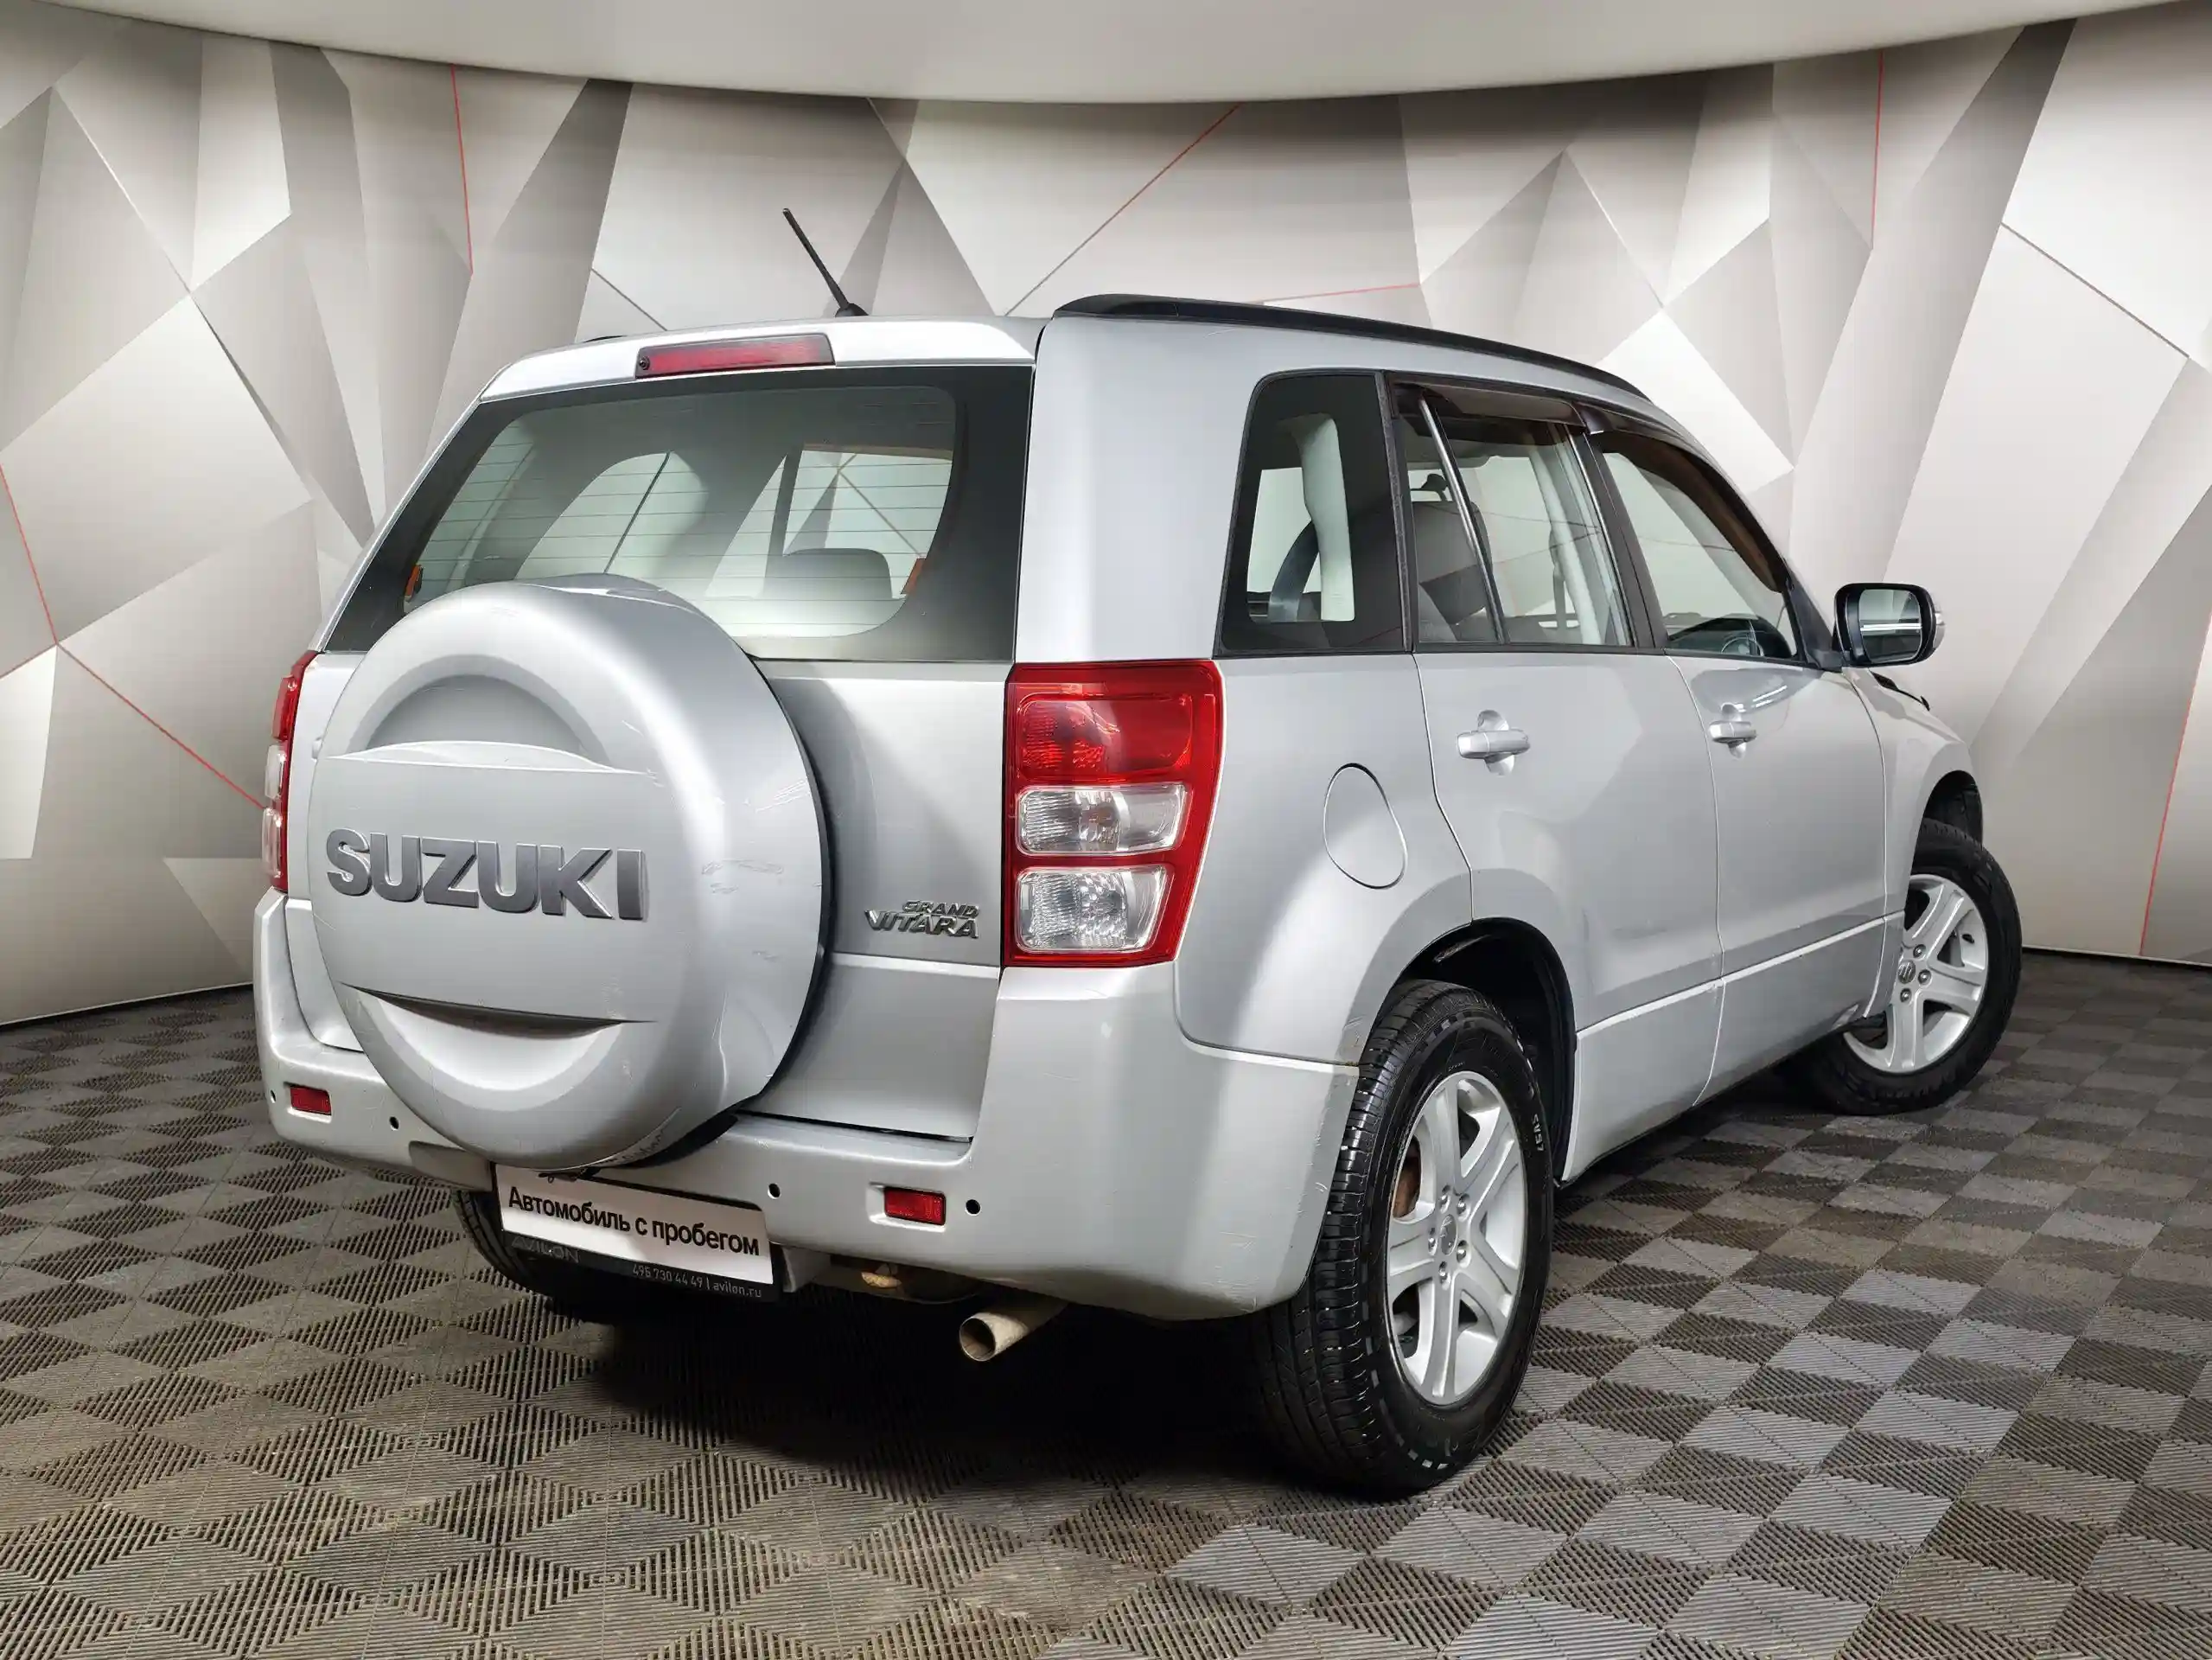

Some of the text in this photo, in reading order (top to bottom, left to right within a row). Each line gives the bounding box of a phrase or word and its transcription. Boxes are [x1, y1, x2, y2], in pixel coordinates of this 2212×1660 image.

[326, 827, 648, 922] SUZUKI
[902, 899, 979, 918] GRAND
[864, 910, 979, 939] VITARA
[509, 1186, 760, 1256] Автомобиль с пробегом
[512, 1235, 579, 1263] AVILON
[653, 1268, 673, 1281] 730
[675, 1273, 688, 1286] 44
[691, 1275, 703, 1288] 49
[713, 1281, 762, 1298] avilon.ru
